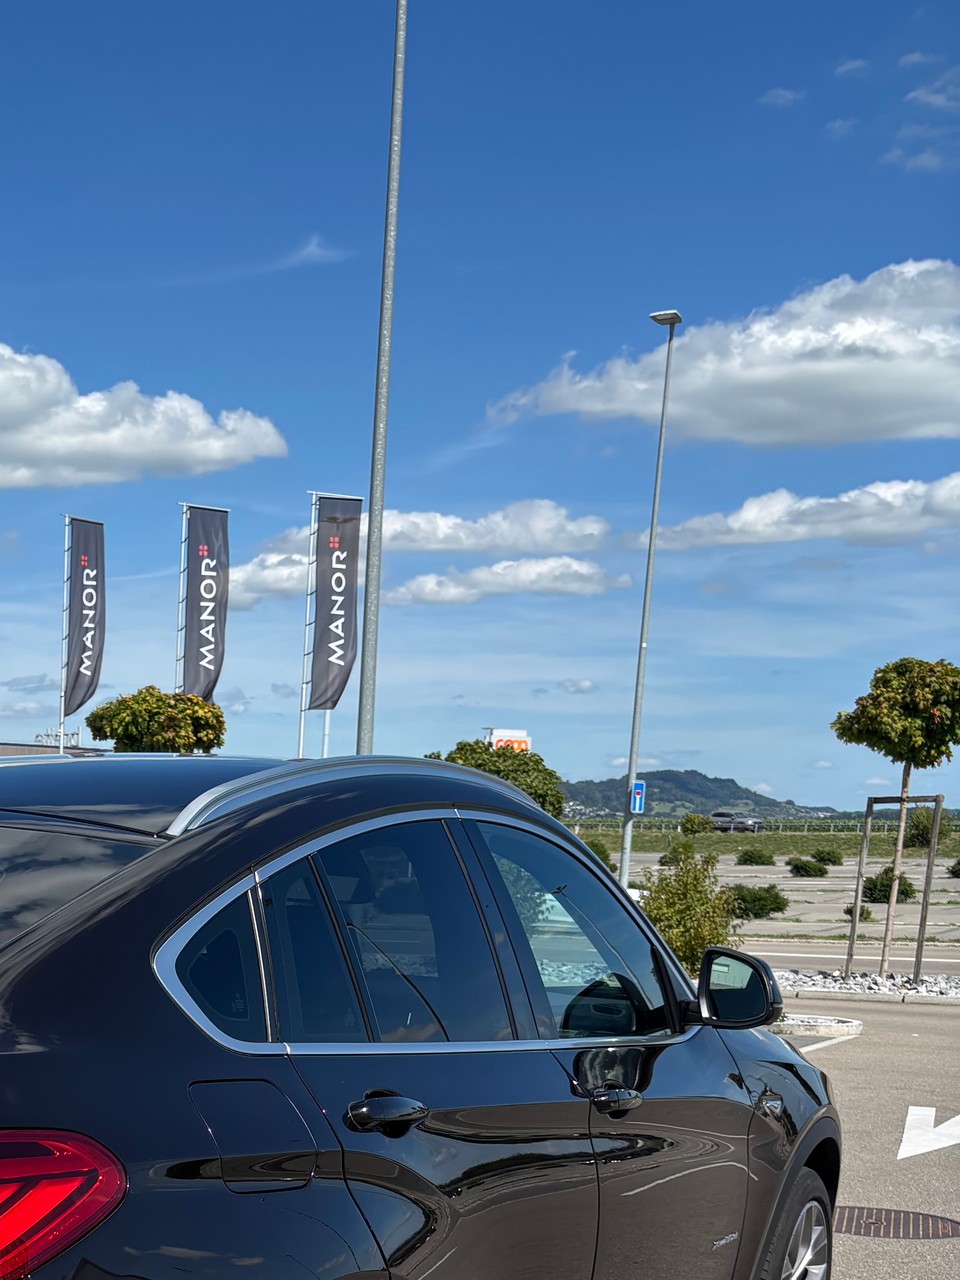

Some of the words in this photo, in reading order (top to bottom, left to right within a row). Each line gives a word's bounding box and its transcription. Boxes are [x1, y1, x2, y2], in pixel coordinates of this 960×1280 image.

[79, 568, 97, 676] MANOR
[199, 558, 217, 670] MANOR
[327, 550, 347, 666] MANOR
